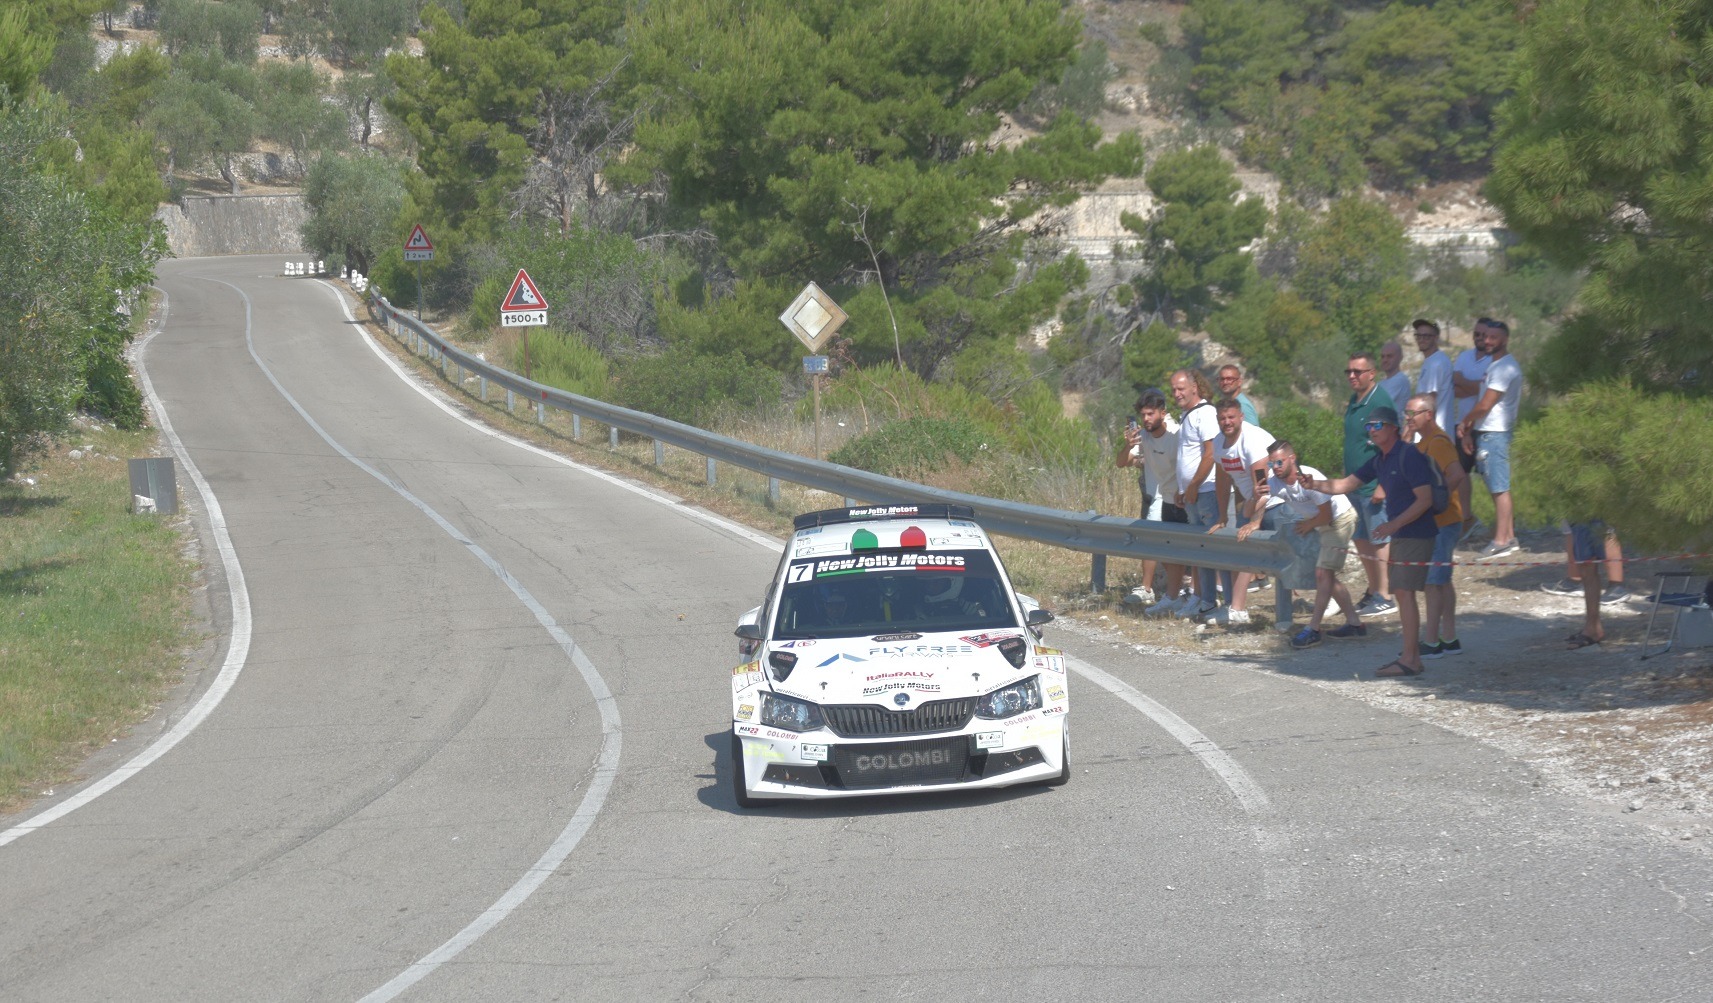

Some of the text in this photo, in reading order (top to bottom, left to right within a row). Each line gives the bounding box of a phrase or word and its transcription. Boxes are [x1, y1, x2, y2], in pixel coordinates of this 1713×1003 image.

[511, 314, 532, 323] 500
[867, 507, 887, 515] Jolly
[888, 506, 919, 515] Motors
[816, 553, 965, 573] New Jolly Motors
[795, 564, 809, 582] 7
[869, 645, 973, 656] FLY FREE
[866, 671, 935, 682] ItaliaRALLY
[862, 682, 941, 694] New Jolly Motors
[1003, 714, 1037, 727] COLOMBI
[766, 730, 799, 741] COLOMBI
[856, 748, 951, 771] COLOMBI
